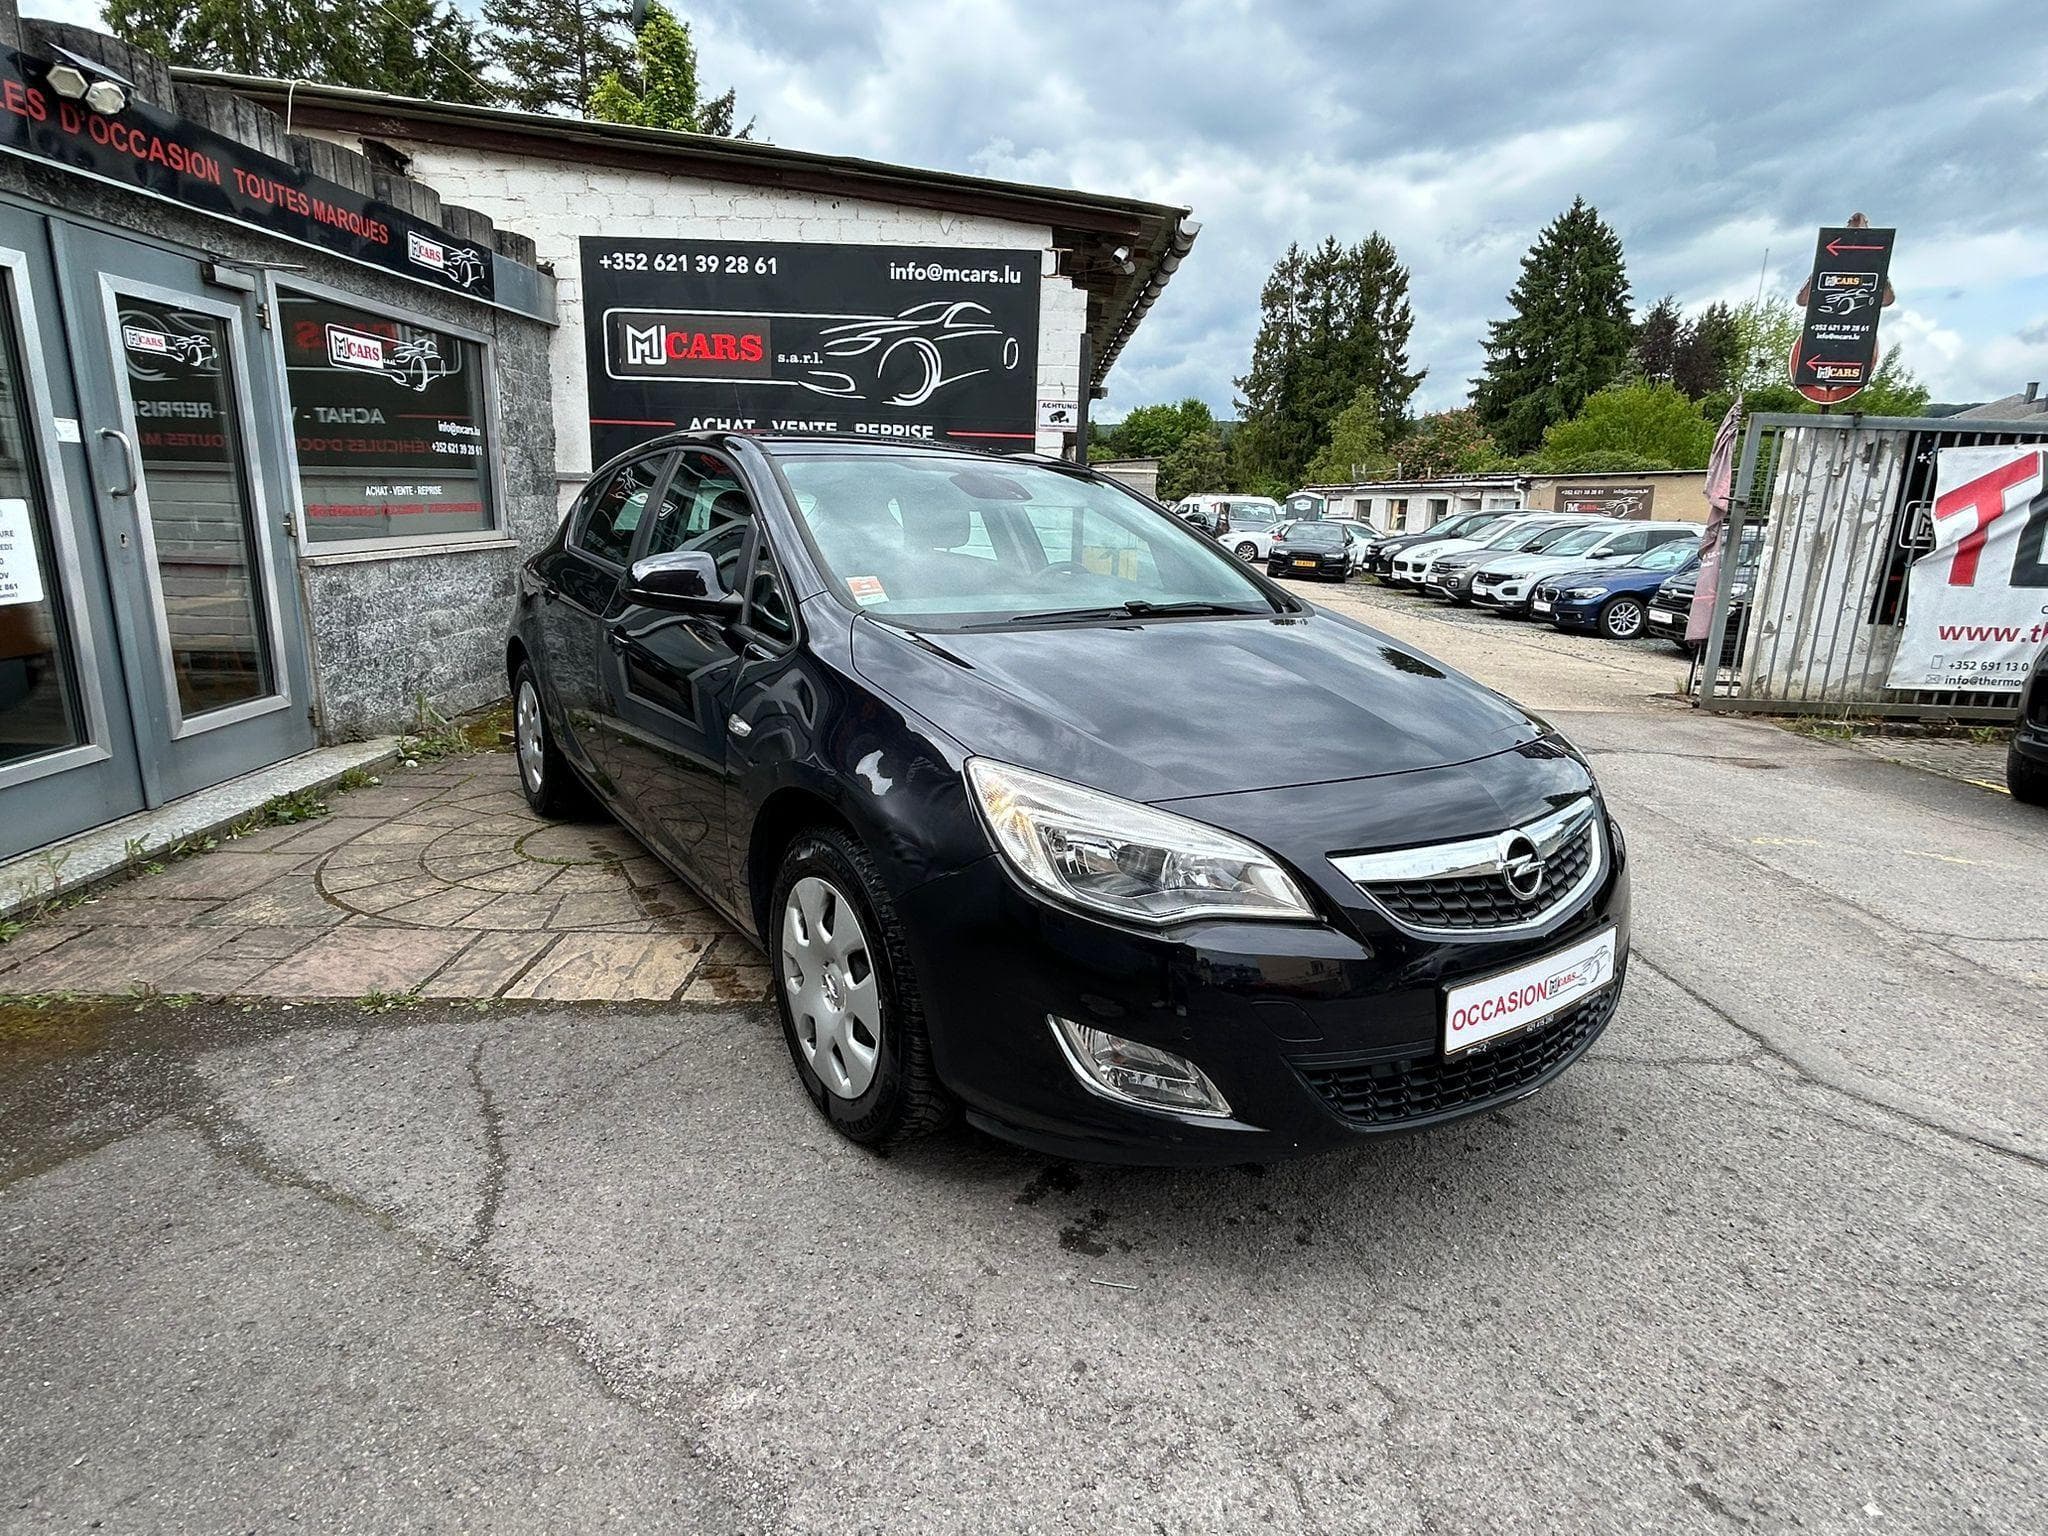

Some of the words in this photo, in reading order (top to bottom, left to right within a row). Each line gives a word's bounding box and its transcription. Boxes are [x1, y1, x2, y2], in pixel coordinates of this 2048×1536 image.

[0, 79, 46, 121] ES
[59, 101, 221, 185] D'OCCASION
[232, 167, 310, 216] TOUTES
[313, 197, 389, 244] MARQUES
[599, 251, 649, 271] +352
[653, 253, 688, 272] 621
[695, 254, 719, 273] 39
[724, 255, 749, 274] 28
[754, 257, 777, 275] 61
[889, 262, 1022, 285] info@mcars.lu
[777, 352, 824, 364] s.a.r.l.
[689, 417, 757, 431] ACHAT
[771, 420, 838, 432] VENTE
[1948, 661, 1977, 670] +352
[1980, 661, 2000, 671] 691
[2005, 662, 2018, 671] 13
[1452, 979, 1548, 1031] OCCASION
